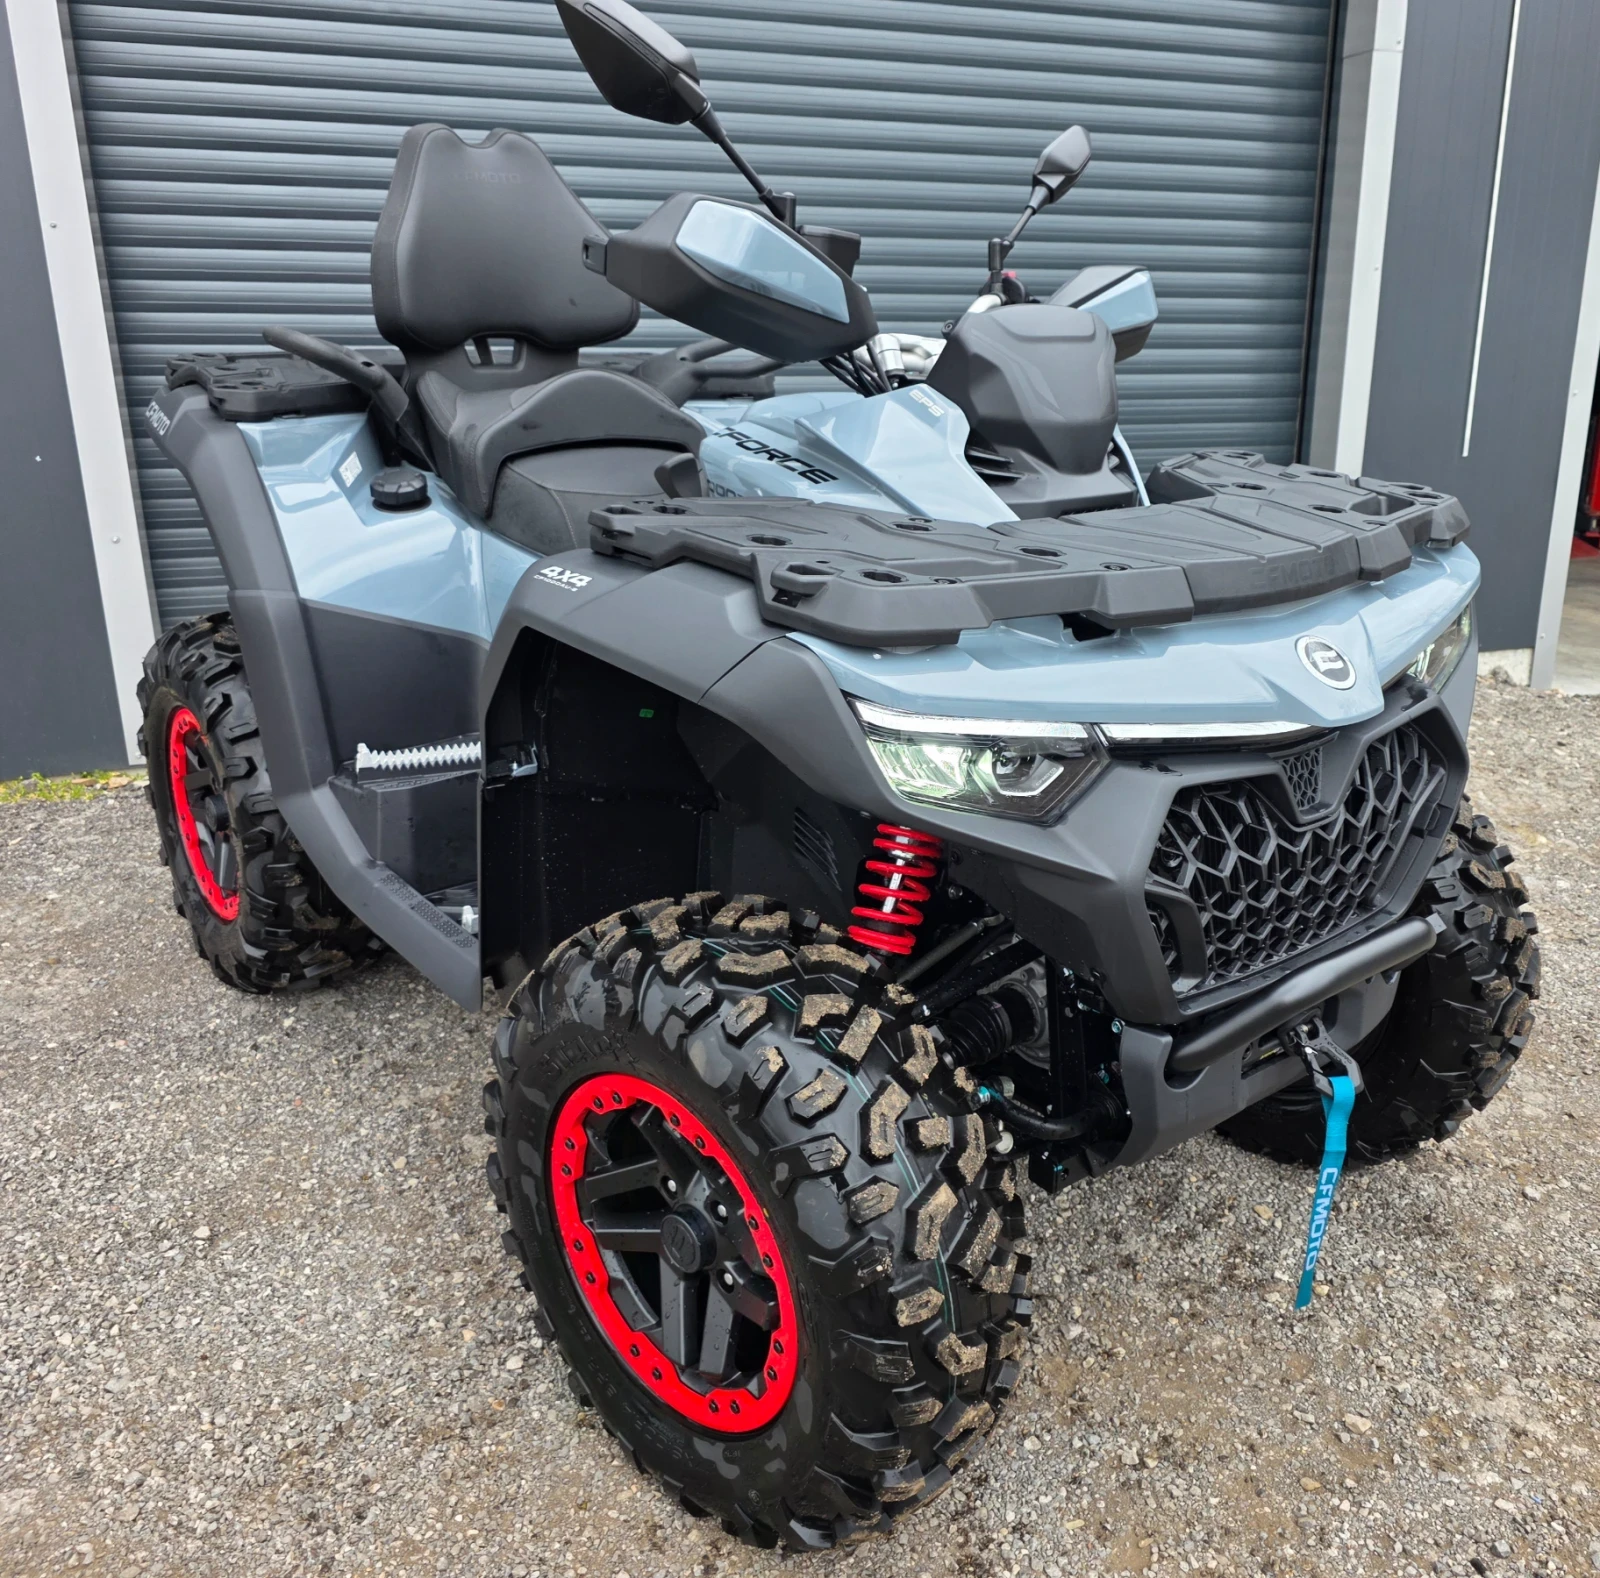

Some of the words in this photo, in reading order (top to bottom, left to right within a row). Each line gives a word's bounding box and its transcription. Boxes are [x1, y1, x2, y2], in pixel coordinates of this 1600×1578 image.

[145, 401, 171, 436] CFMOTO
[908, 389, 945, 417] EPS
[1305, 1167, 1339, 1272] CFMOTO
